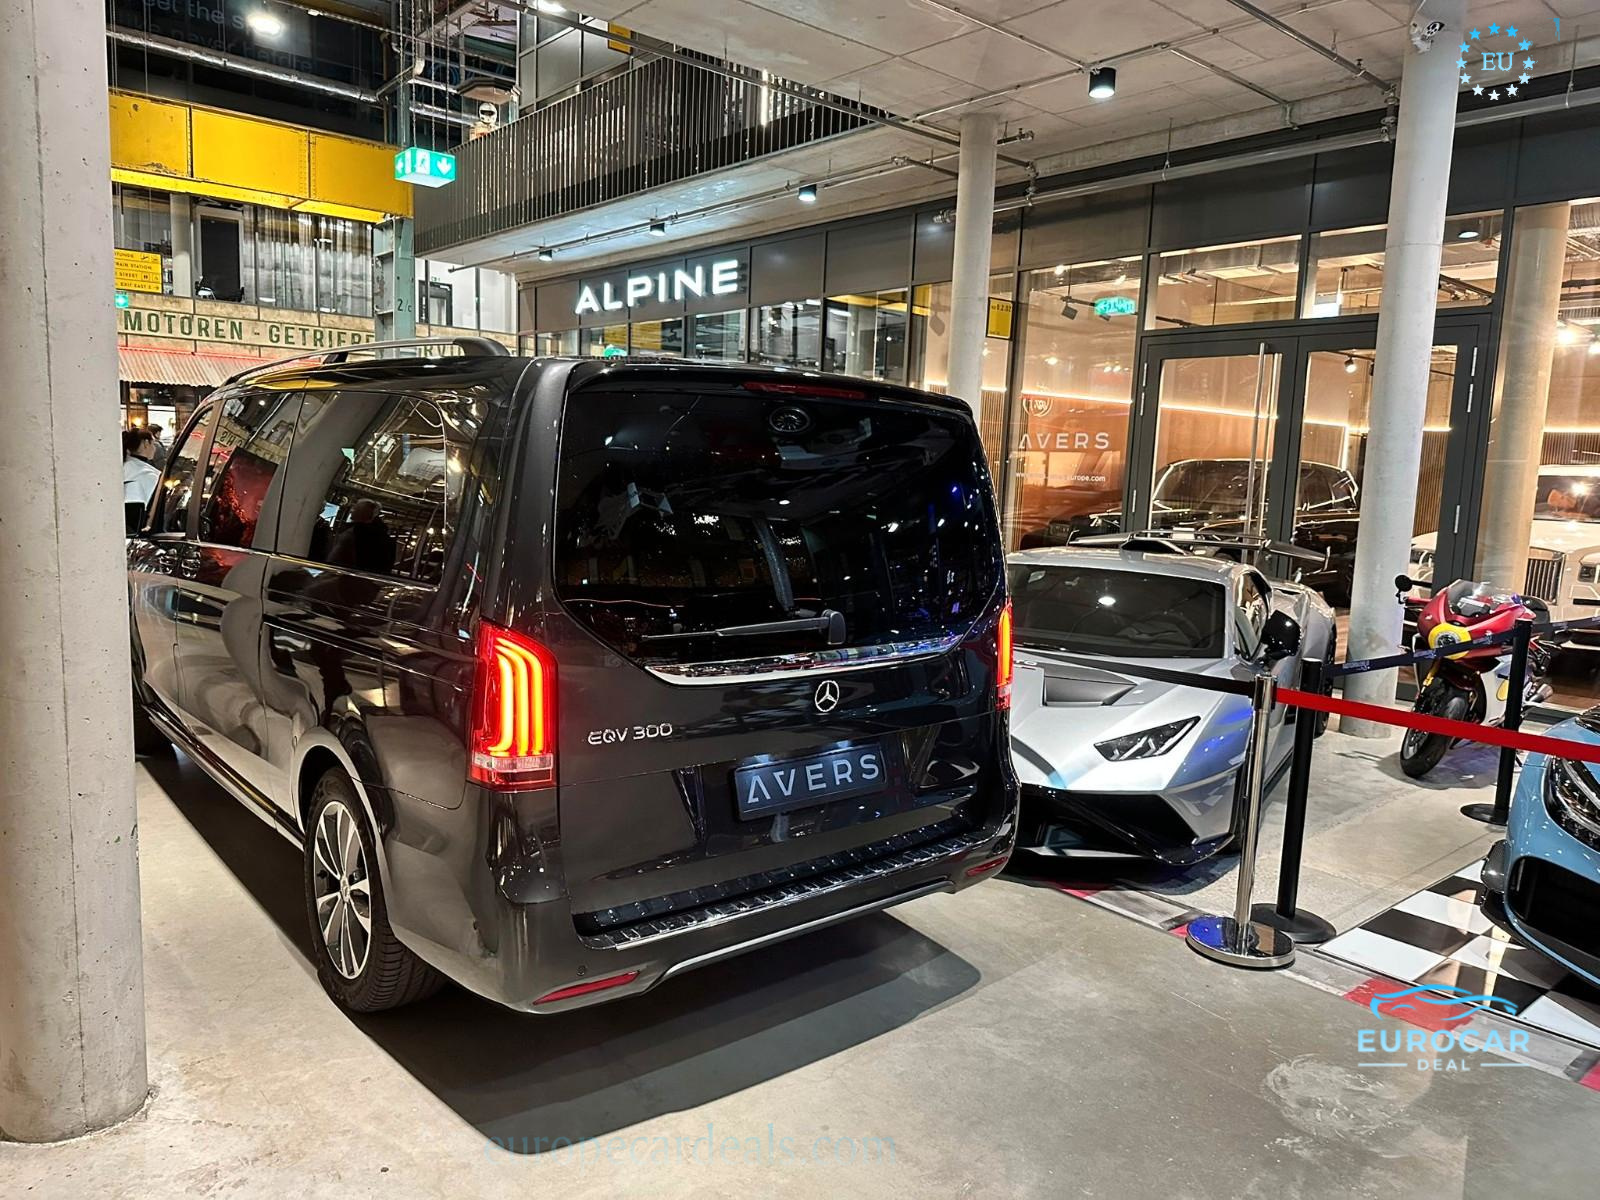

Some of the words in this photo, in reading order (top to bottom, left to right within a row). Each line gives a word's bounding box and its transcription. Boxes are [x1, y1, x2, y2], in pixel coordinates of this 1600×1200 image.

[575, 259, 739, 314] ALPINE
[123, 310, 243, 341] MOTOREN
[1018, 431, 1110, 449] AVERS
[587, 727, 629, 746] EQV
[632, 722, 673, 740] 300
[747, 753, 880, 804] AVERS
